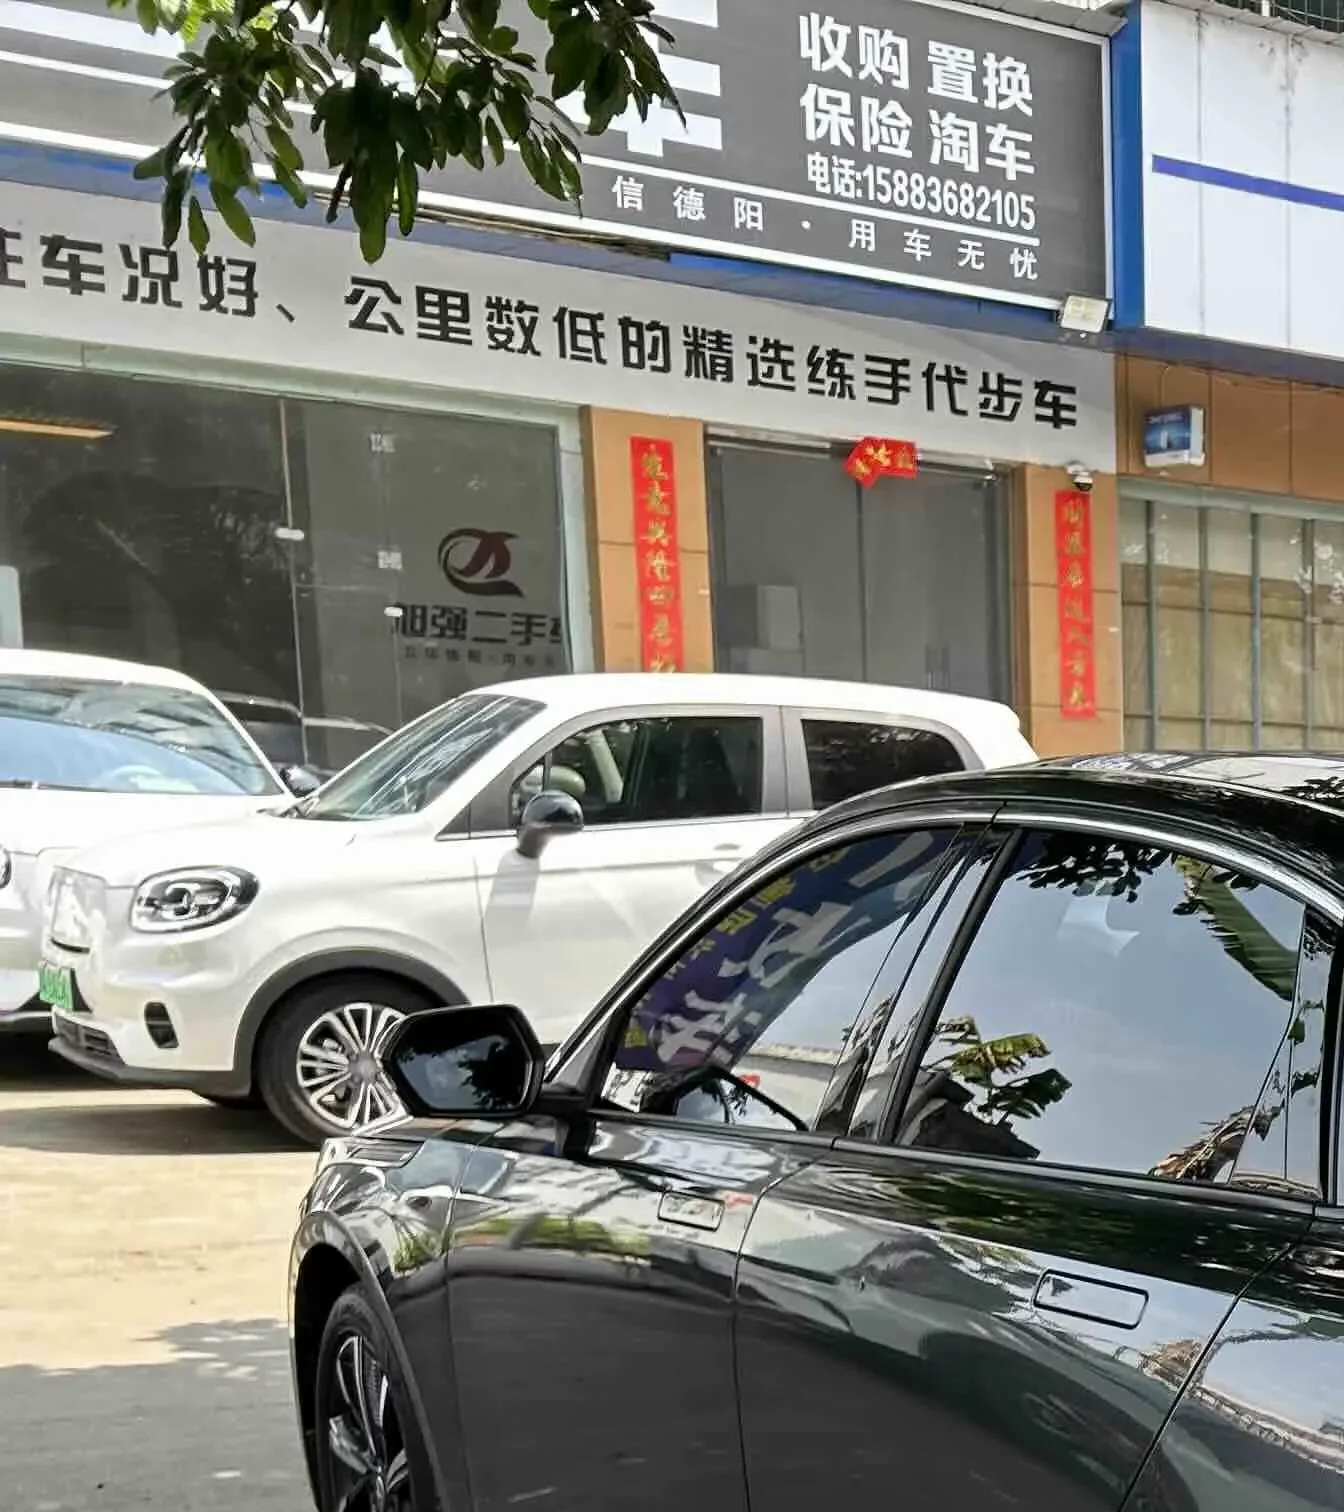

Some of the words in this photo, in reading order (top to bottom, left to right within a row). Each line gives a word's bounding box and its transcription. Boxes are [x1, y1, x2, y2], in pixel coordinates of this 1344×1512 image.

[800, 11, 910, 90] 收购
[926, 39, 1034, 117] 置换
[800, 82, 913, 159] 保险
[928, 108, 1035, 181] 淘车
[807, 151, 1035, 232] 电话:15883682105
